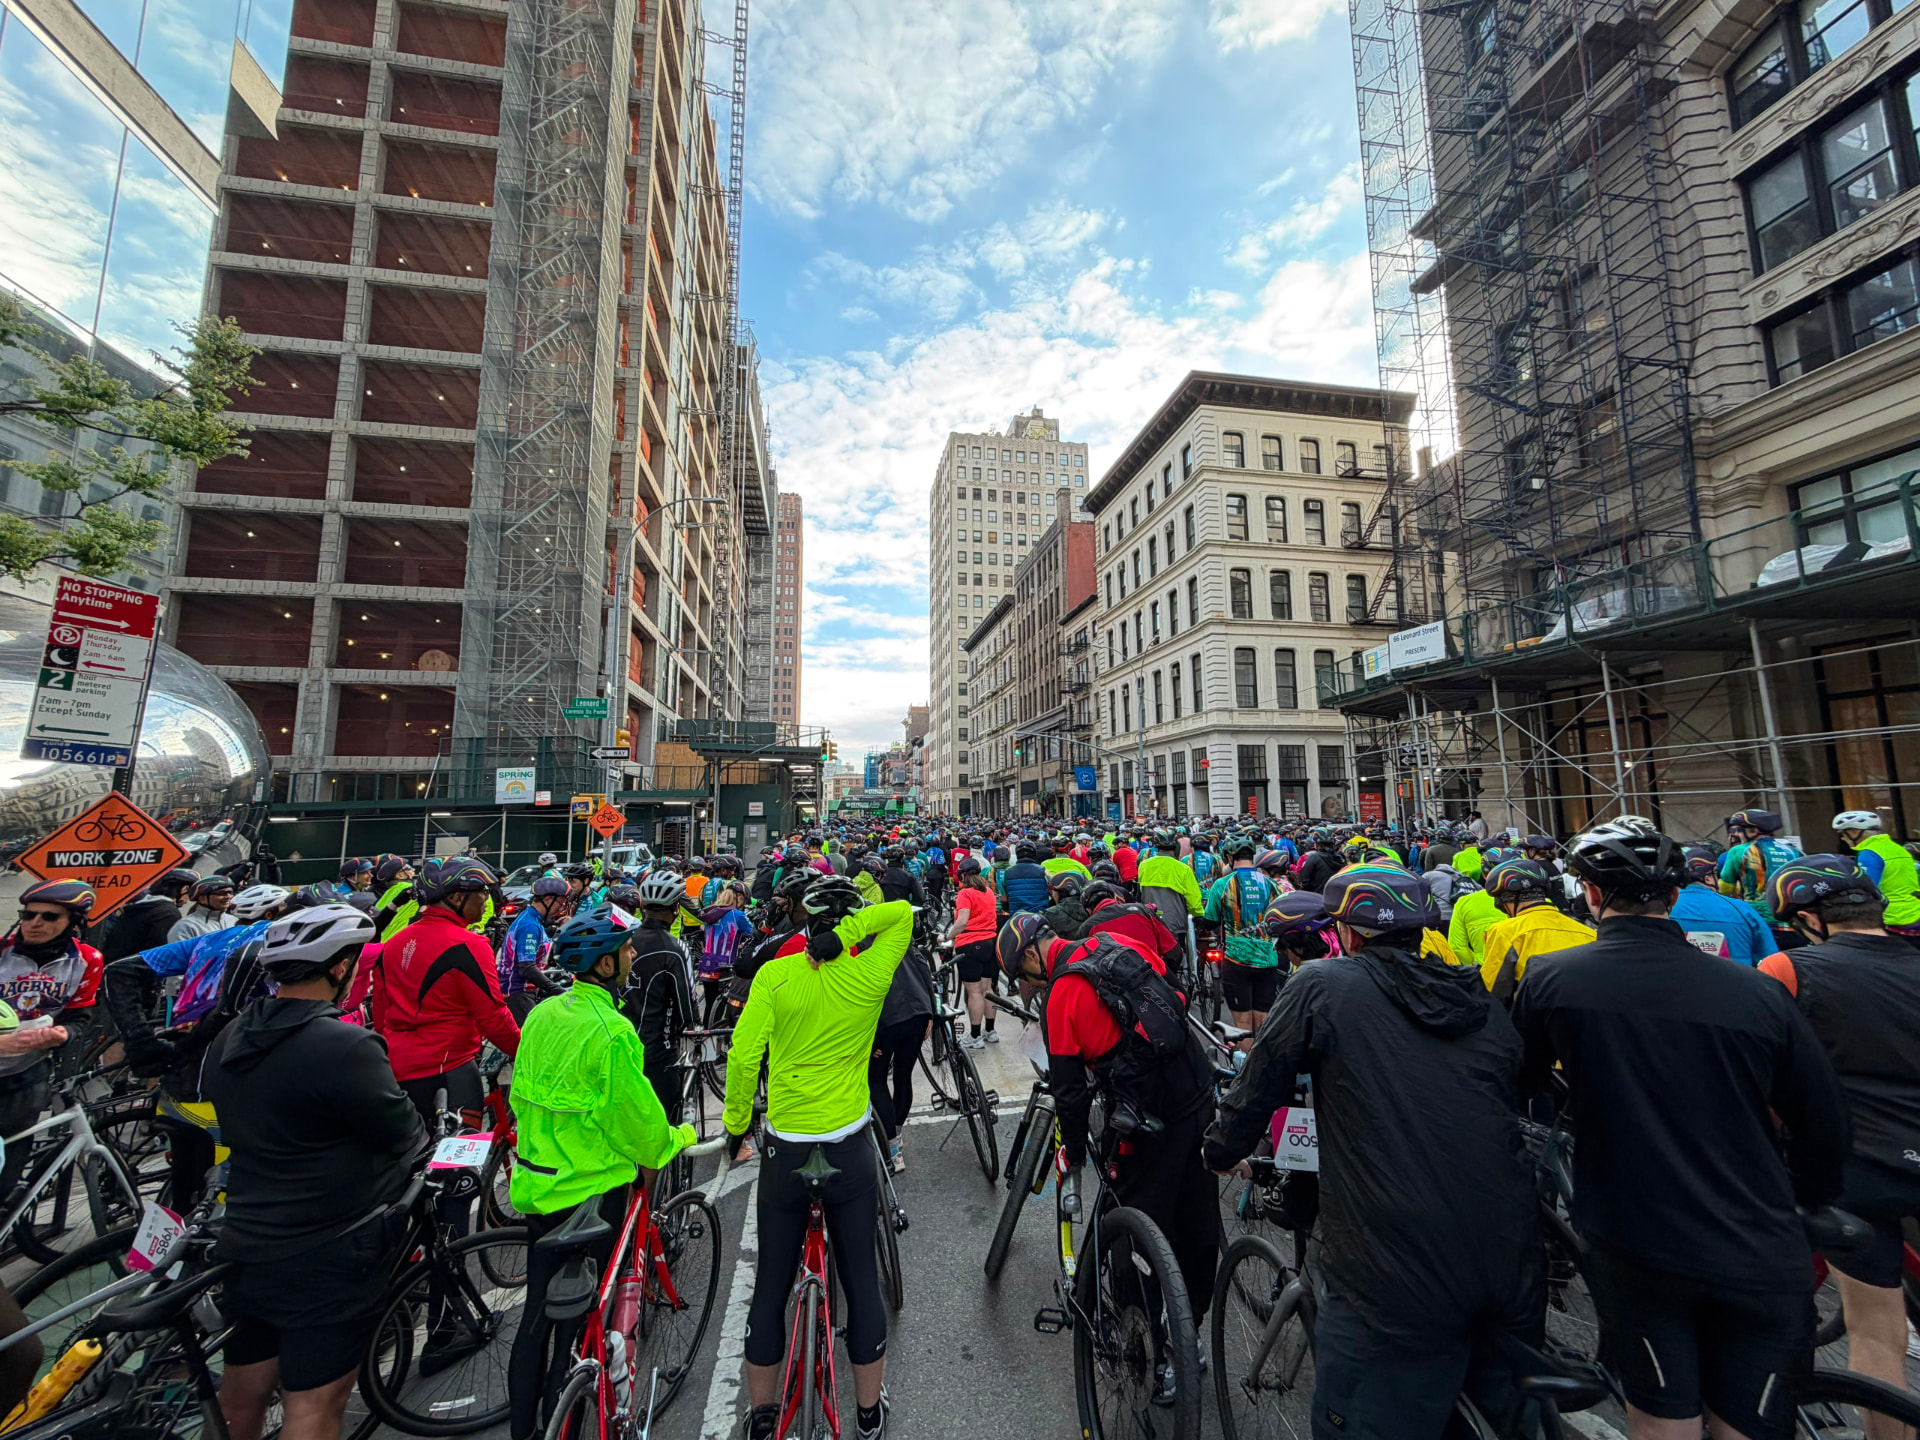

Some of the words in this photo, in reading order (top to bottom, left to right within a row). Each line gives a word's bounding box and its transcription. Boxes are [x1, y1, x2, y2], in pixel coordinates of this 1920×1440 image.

[62, 581, 81, 592] NO
[84, 586, 143, 605] STOPPING
[61, 593, 113, 610] Anytime
[87, 632, 118, 644] Monday
[1401, 630, 1420, 641] Leonard
[1422, 625, 1439, 635] Street
[86, 640, 122, 652] Thursday
[1405, 646, 1427, 656] PRESERV
[83, 650, 101, 658] 2am
[108, 654, 125, 662] 6am
[47, 670, 66, 688] 2
[77, 681, 112, 690] metered
[75, 687, 107, 697] parking
[40, 696, 61, 705] 7am
[71, 699, 91, 709] 7pm
[575, 699, 600, 707] Leonard
[38, 705, 73, 716] Except
[75, 709, 112, 721] Sunday
[40, 747, 105, 764] 105661
[54, 852, 106, 866] WORK
[111, 850, 158, 865] ZONE
[77, 874, 131, 889] HEAD
[156, 1227, 174, 1256] V985
